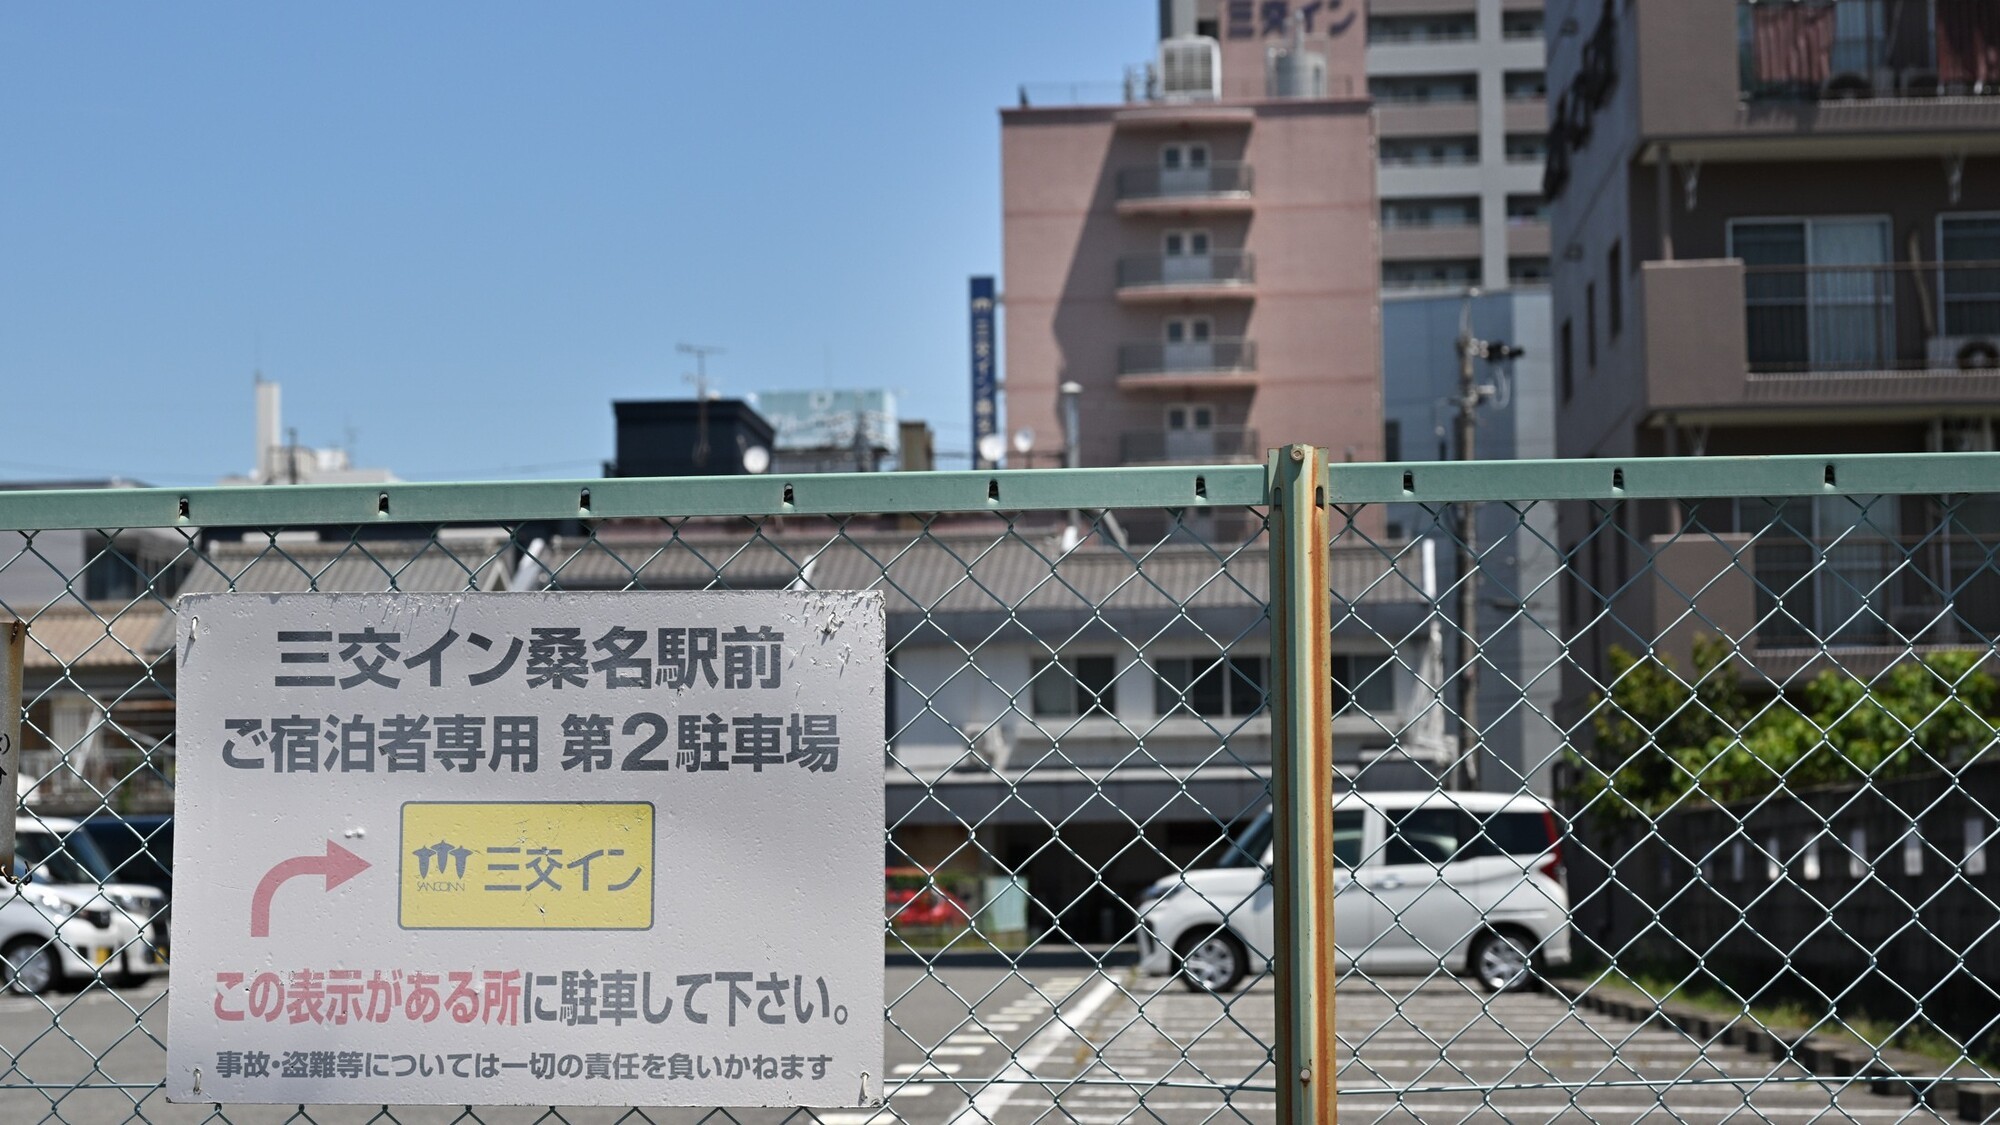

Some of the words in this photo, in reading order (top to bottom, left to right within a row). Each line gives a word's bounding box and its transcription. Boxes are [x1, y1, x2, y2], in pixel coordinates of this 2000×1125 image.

[275, 625, 785, 691] 三交イン桑名駅前
[221, 713, 539, 774] ご宿泊者専用
[560, 712, 840, 774] 第2駐車場
[484, 846, 642, 892] 三交イン
[213, 967, 848, 1027] この表示がある所に駐車して下さい。
[215, 1050, 833, 1080] 事故・盗難等については一切の責任を負いかねます
